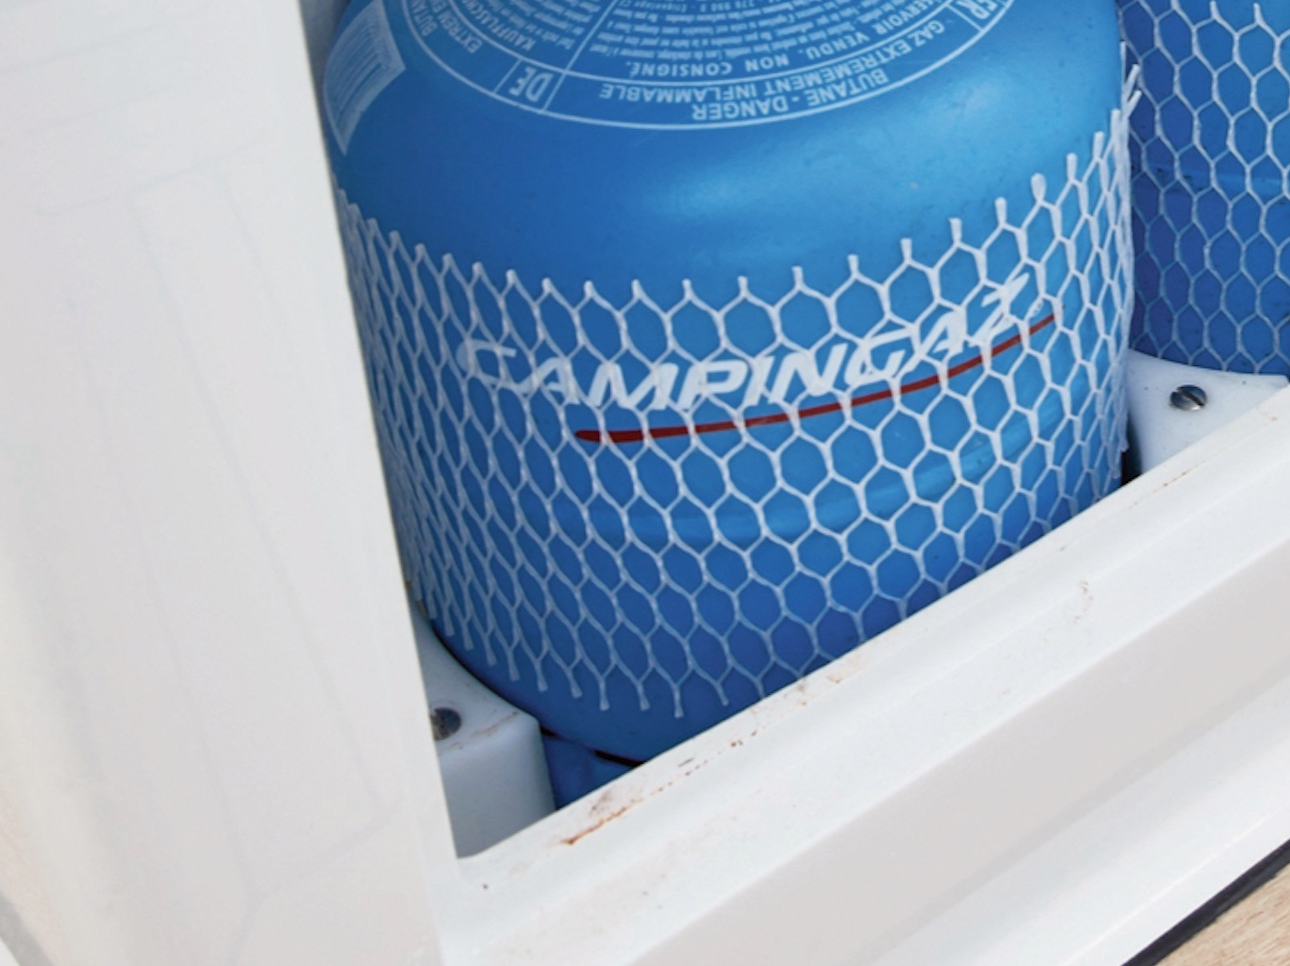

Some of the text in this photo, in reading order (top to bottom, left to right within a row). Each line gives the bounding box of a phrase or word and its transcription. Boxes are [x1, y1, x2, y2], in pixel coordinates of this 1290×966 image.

[907, 19, 946, 47] GAZ
[744, 54, 790, 73] NON
[509, 67, 554, 102] DE
[600, 83, 759, 103] INFLAMMABLE
[803, 68, 889, 104] BUTANE
[692, 95, 789, 121] DANGER
[457, 271, 1034, 412] CAMPINGAZ
